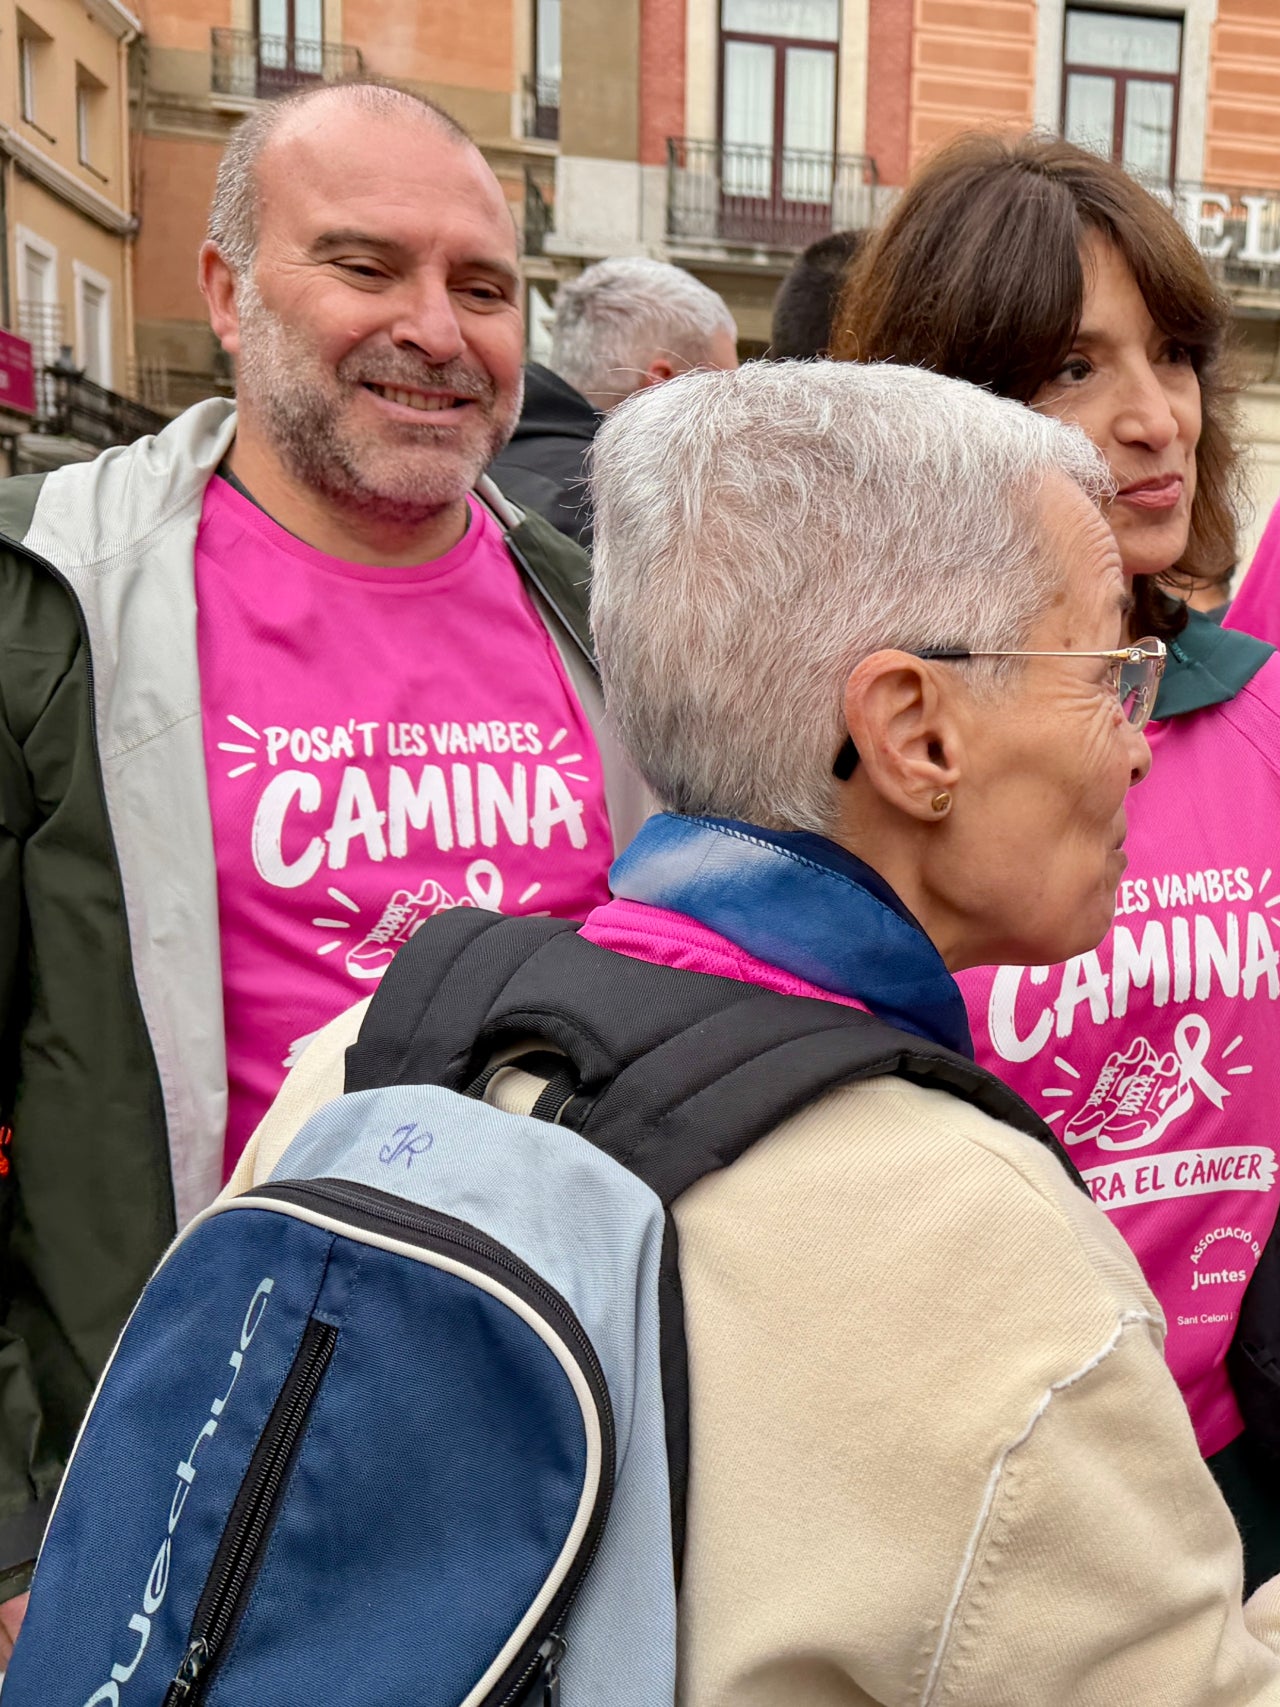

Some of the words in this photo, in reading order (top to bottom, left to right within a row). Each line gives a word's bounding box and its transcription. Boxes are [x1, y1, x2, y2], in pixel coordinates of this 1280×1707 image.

[262, 719, 380, 766] POSA'T
[387, 721, 427, 757] LES
[429, 720, 543, 756] VAMBES
[251, 761, 588, 889] CAMINA
[1152, 866, 1254, 909] VAMBES
[987, 911, 1280, 1063] CAMINA
[1134, 1165, 1165, 1194] EL
[1174, 1153, 1263, 1188] CÀNCER
[1190, 1226, 1252, 1265] ASSOCIACIÓ
[1190, 1268, 1247, 1291] Juntes
[1176, 1315, 1199, 1326] Sant
[1200, 1313, 1229, 1324] Celoni
